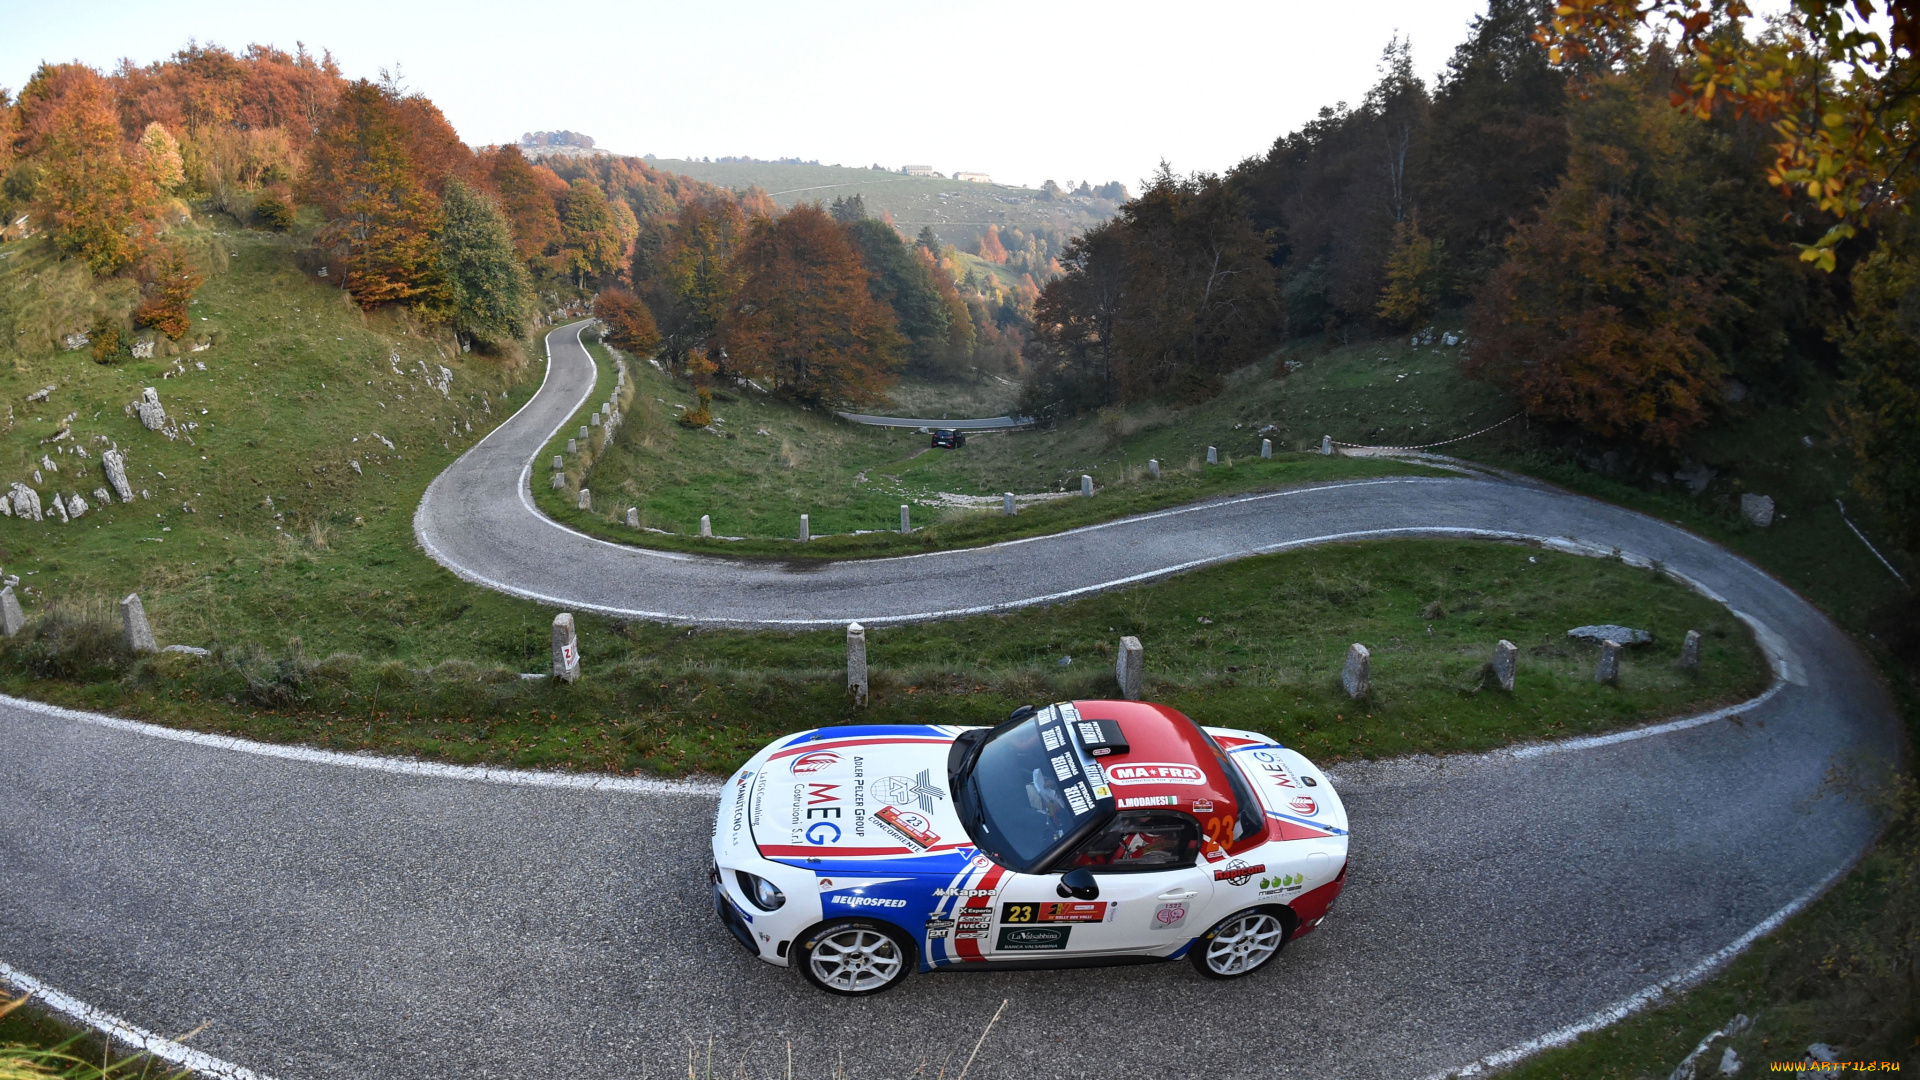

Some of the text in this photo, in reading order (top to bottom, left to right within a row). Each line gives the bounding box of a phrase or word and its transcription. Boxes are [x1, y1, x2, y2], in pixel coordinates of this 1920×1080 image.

[1041, 728, 1060, 751] SELENIA
[1054, 725, 1066, 746] PETRONAS
[1078, 722, 1099, 744] SELENIA
[1092, 721, 1106, 743] PETRONAS
[1051, 754, 1072, 781] SELENIA
[1064, 751, 1079, 776] PETRONAS
[1253, 752, 1296, 788] MEG
[854, 756, 865, 837] ADLER PELZER GROUP
[1063, 784, 1089, 816] SELENIA
[1077, 781, 1095, 809] PETRONAS
[1118, 796, 1168, 808] A.MODANESI
[806, 783, 842, 845] MEG
[906, 816, 923, 827] 23
[868, 816, 921, 854] CONCORRENTE
[1206, 815, 1234, 852] 23
[1214, 864, 1265, 881] Rapicom
[839, 895, 907, 908] EUROSPEED
[949, 888, 997, 898] Kappa
[1008, 905, 1032, 922] 23
[1020, 931, 1058, 939] Valsabbina
